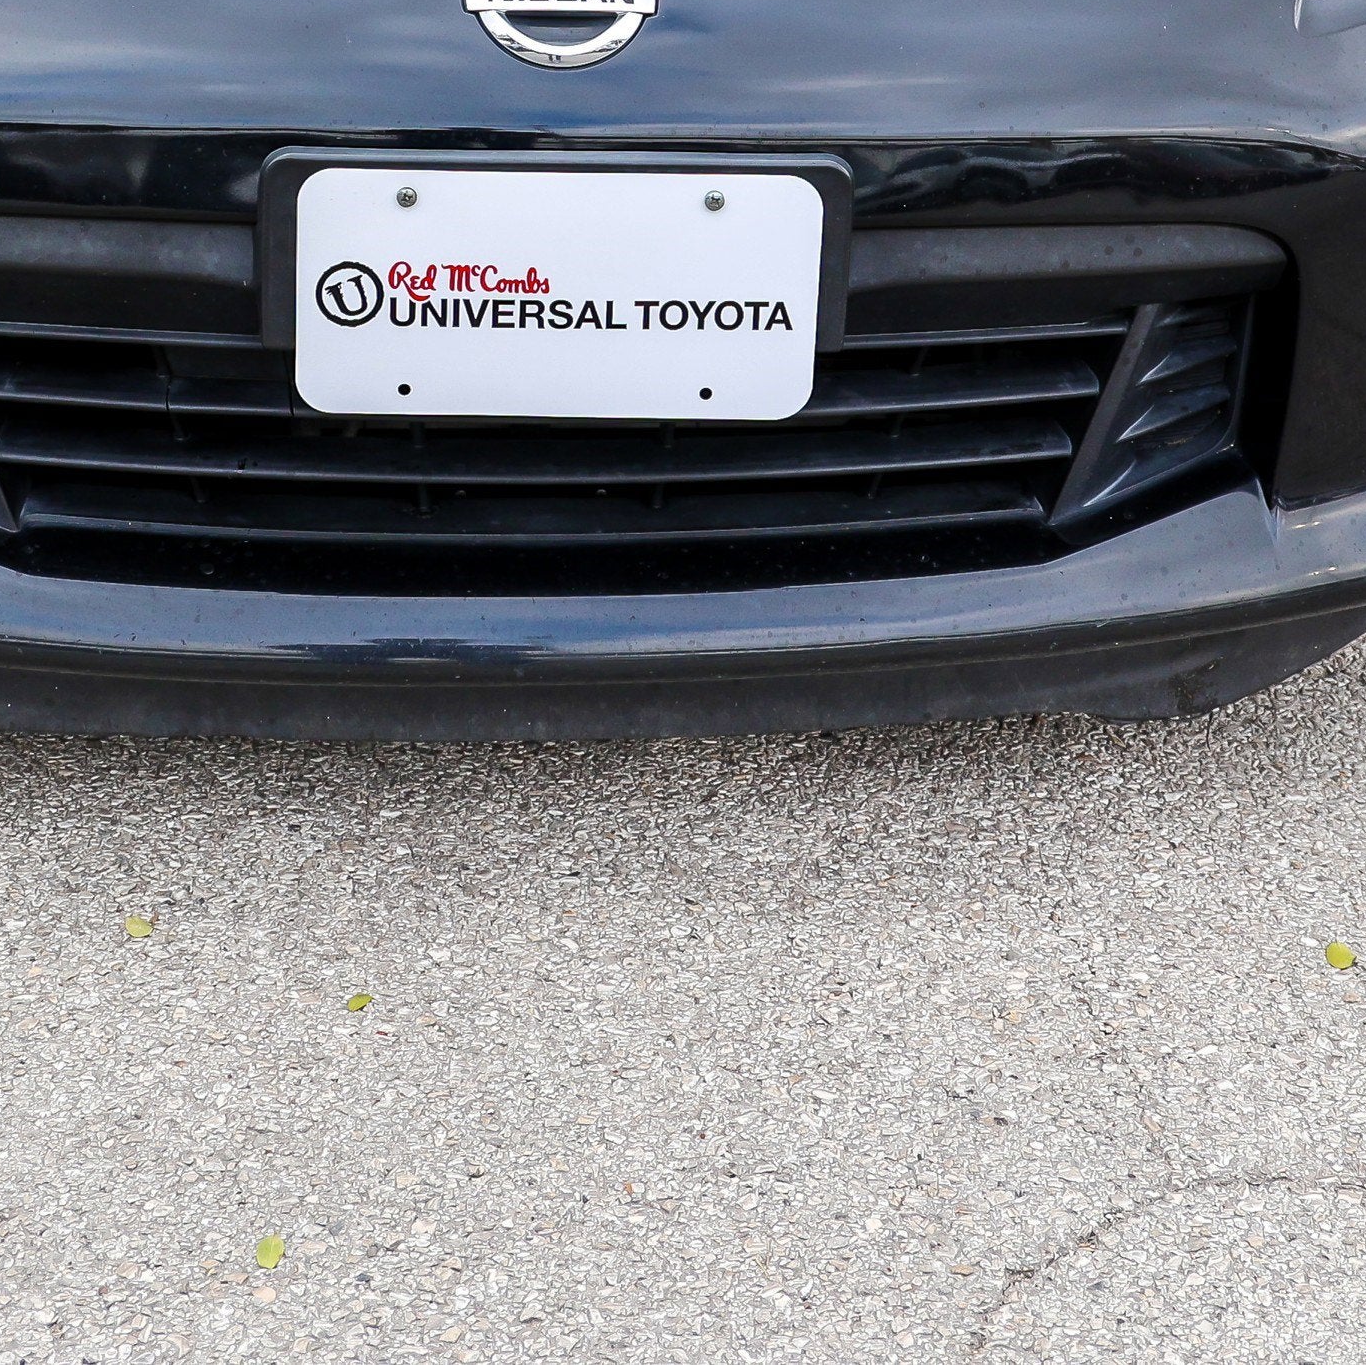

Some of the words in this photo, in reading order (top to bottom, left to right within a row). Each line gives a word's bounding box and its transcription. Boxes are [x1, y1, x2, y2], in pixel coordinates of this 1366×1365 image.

[388, 261, 438, 302] Red
[441, 263, 551, 295] McCombs
[389, 297, 628, 330] UNIVERSAL
[634, 300, 794, 331] TOYOTA
